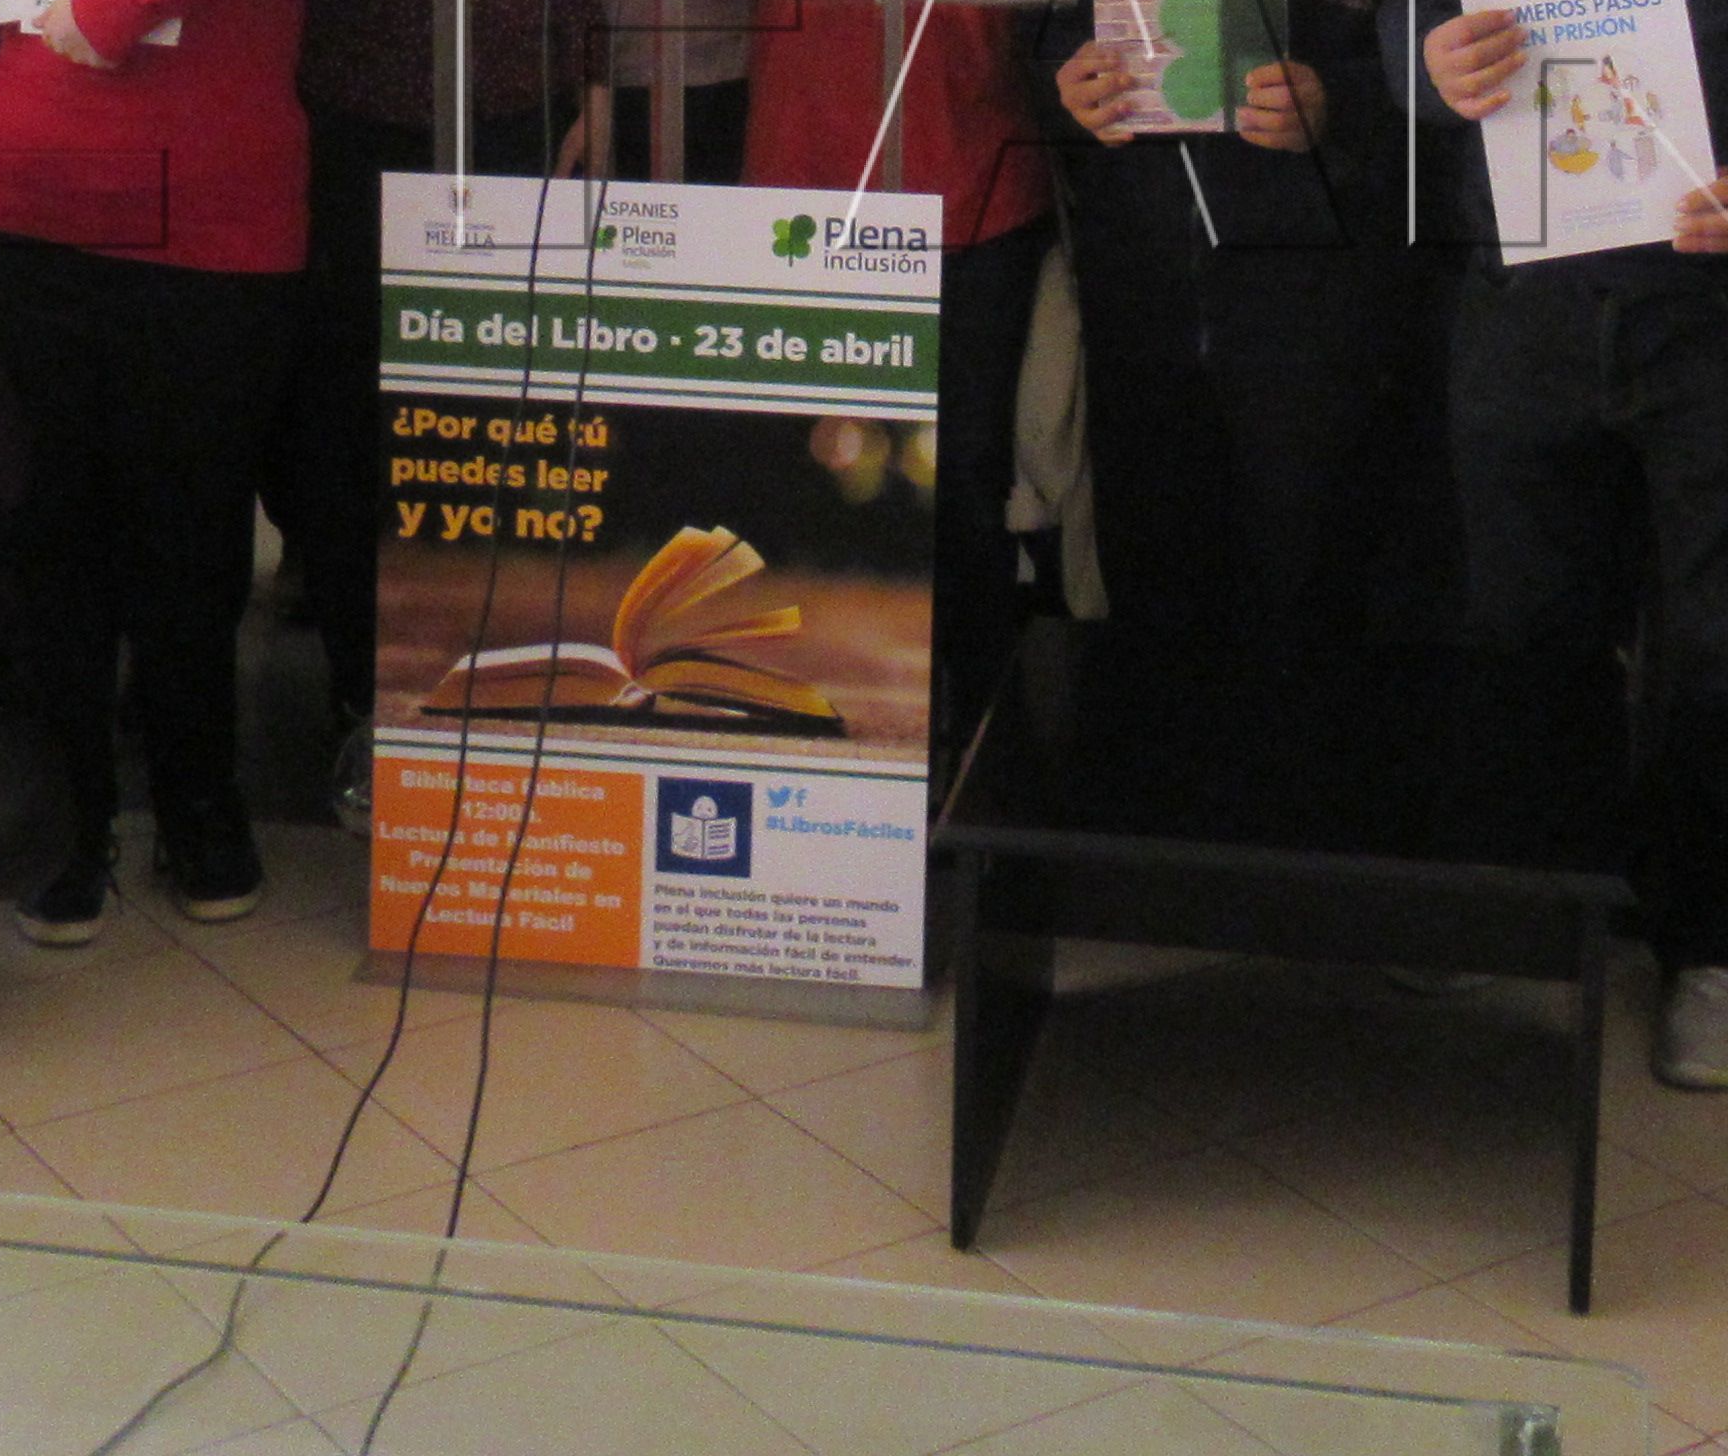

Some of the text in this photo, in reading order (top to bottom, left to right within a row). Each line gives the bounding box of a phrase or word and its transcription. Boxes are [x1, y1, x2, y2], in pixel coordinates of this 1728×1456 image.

[1554, 15, 1637, 44] PRISIÓN
[425, 230, 496, 247] MELLLA
[622, 226, 677, 246] Plena
[824, 217, 928, 252] Plena
[823, 249, 927, 274] inclusión
[399, 309, 464, 343] Día
[476, 313, 539, 347] del
[551, 317, 659, 353] Libro
[694, 325, 744, 358] 23
[756, 328, 808, 361] de
[820, 331, 914, 367] abril
[392, 407, 477, 440] ¿Por
[486, 413, 558, 447] qué
[390, 456, 609, 493] puedes leer
[397, 501, 604, 542] y yo no?
[472, 829, 500, 846] de
[564, 861, 593, 880] de
[469, 880, 588, 907] Maeriales
[594, 894, 622, 908] en
[654, 883, 900, 913] Plena inclusión quiere un mundo
[694, 906, 722, 919] que
[726, 905, 769, 922] todas
[797, 914, 867, 929] personas
[713, 922, 779, 940] disfrutar
[822, 931, 877, 948] lectura
[689, 939, 781, 958] información
[784, 945, 818, 960] fácil
[652, 954, 729, 971] Queremos
[733, 957, 764, 973] más
[768, 960, 822, 979] lectura
